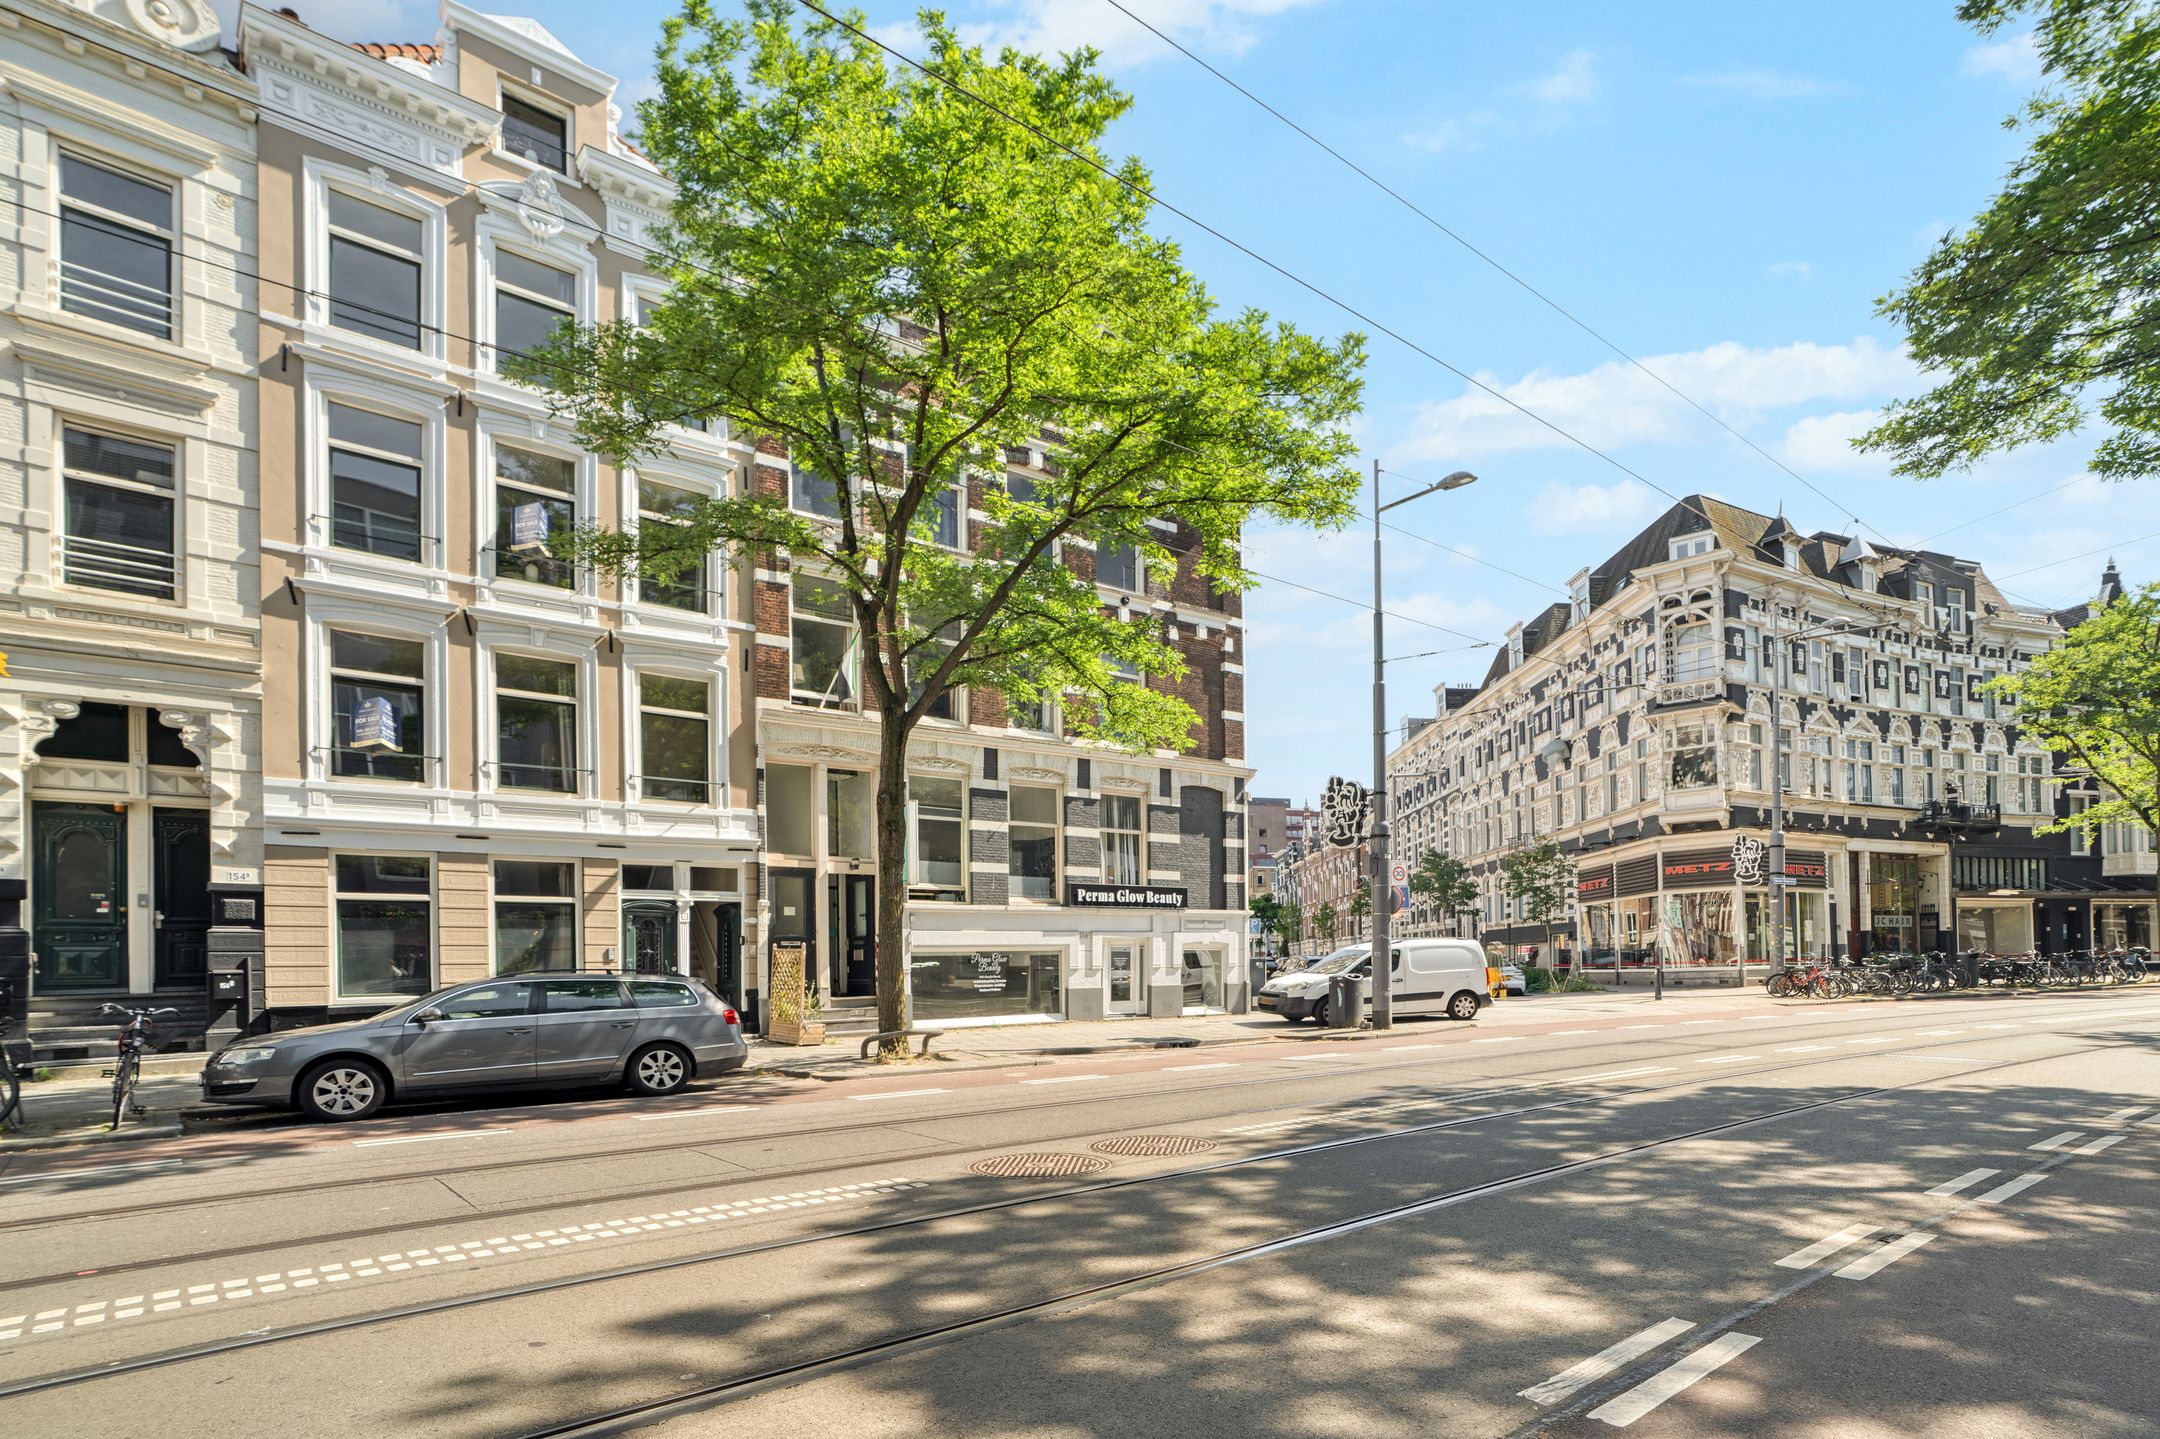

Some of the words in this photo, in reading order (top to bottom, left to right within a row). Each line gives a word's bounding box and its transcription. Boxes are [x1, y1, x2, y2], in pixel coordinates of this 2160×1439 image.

[1665, 861, 1730, 875] METZ
[1785, 864, 1825, 877] METZ
[1577, 877, 1609, 892] METZ
[1077, 888, 1116, 903] Perma
[1116, 889, 1146, 904] Glow
[1146, 890, 1183, 907] Beauty
[970, 953, 991, 964] Perma
[991, 952, 1008, 963] Glow
[978, 961, 1001, 974] Beauty
